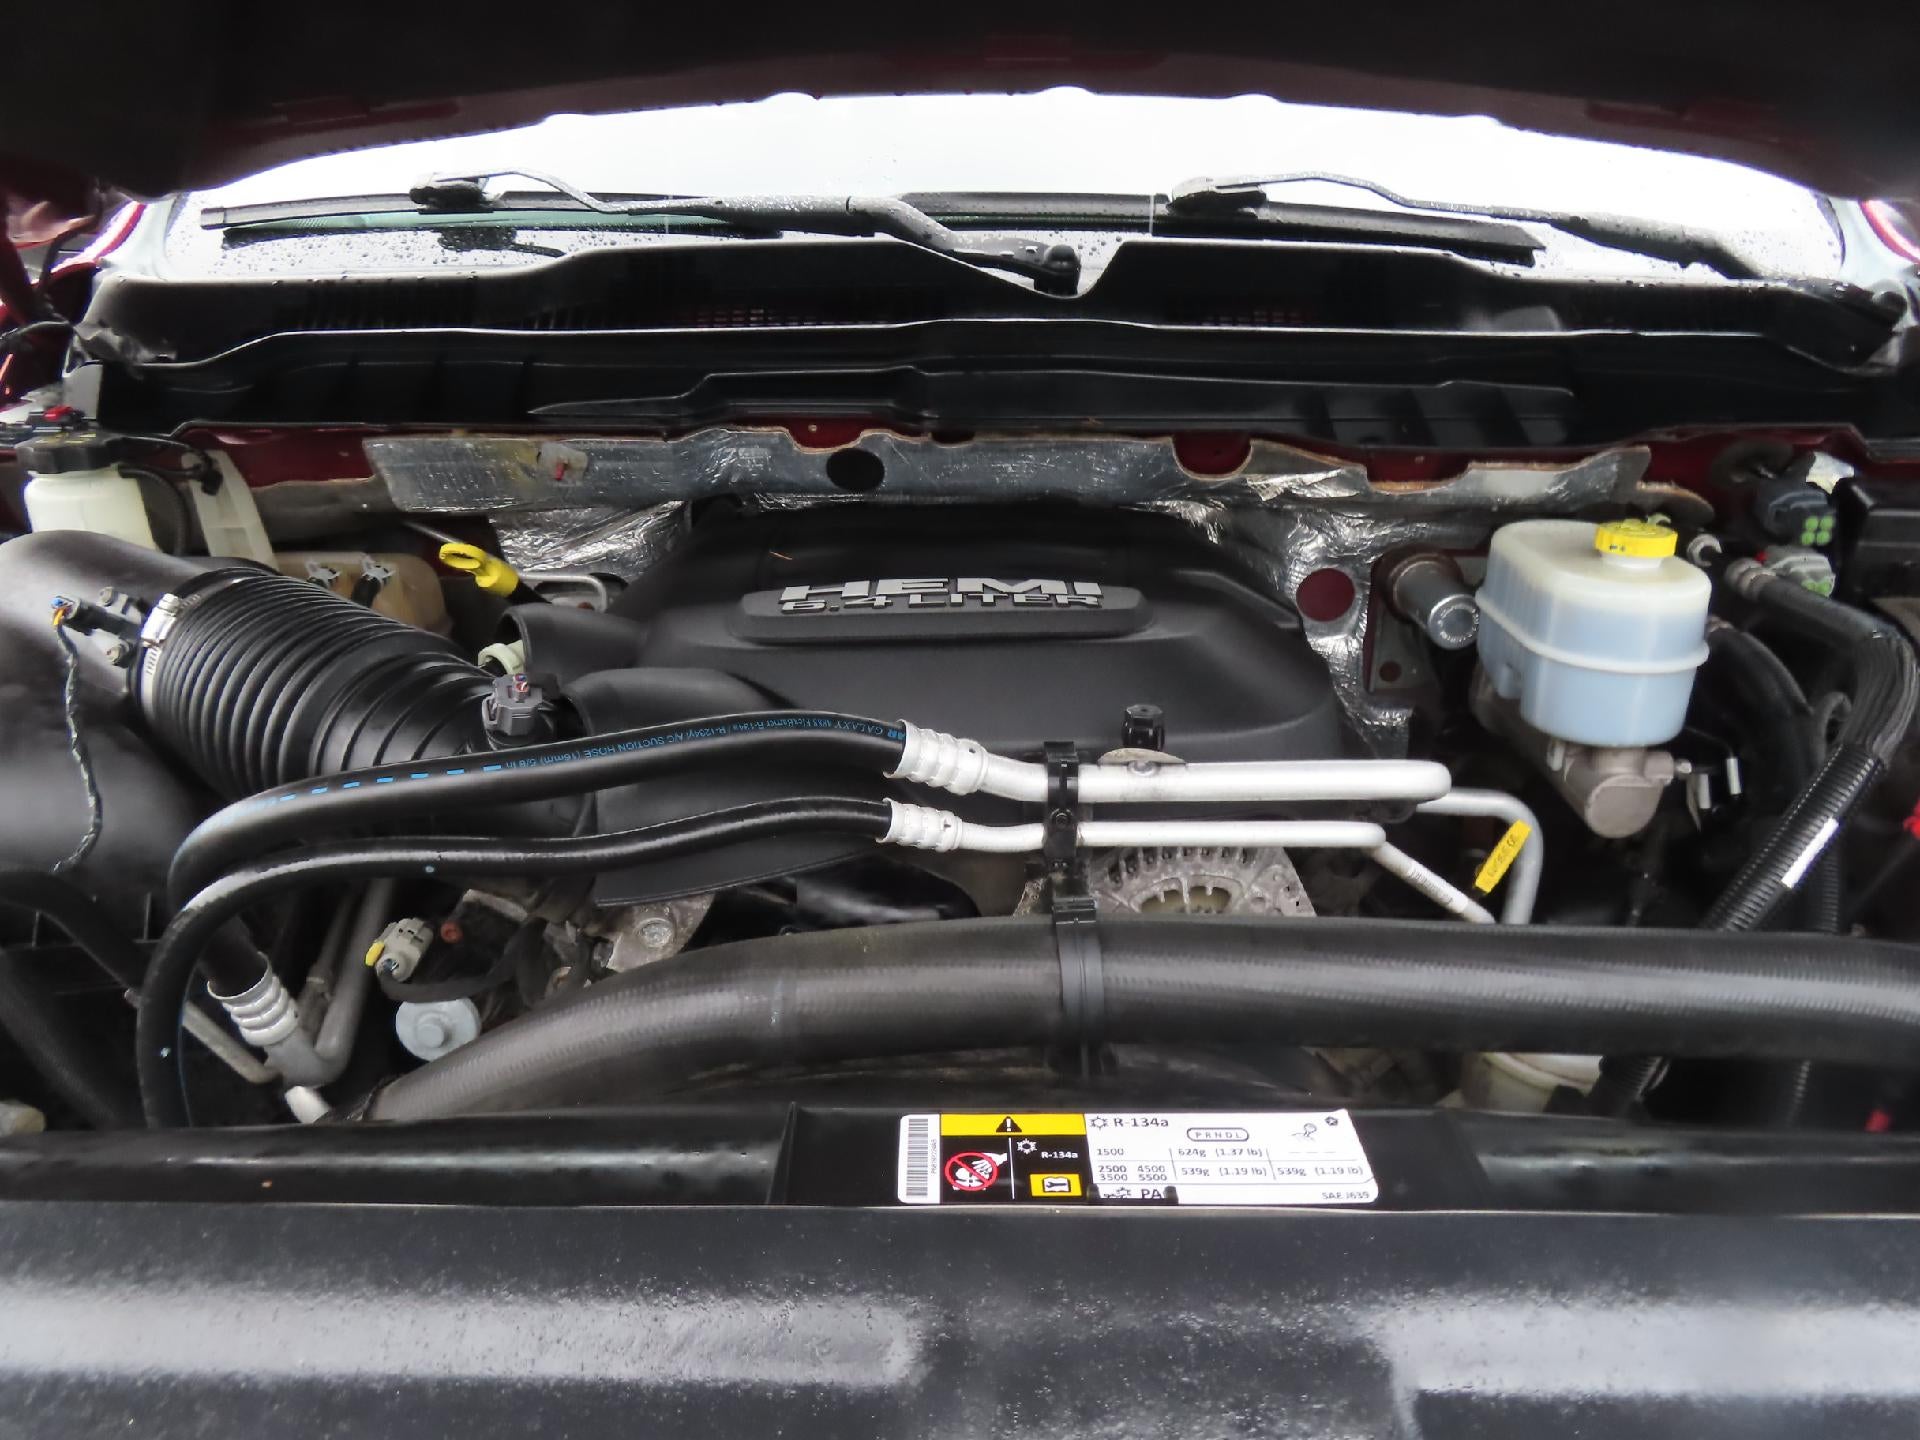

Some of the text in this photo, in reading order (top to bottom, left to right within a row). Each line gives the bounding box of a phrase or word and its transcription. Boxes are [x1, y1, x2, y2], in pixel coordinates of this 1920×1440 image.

[779, 577, 1101, 600] HEMI
[908, 593, 1099, 606] LITER
[835, 722, 883, 735] GALAXY
[667, 733, 683, 743] A/C
[619, 737, 664, 751] SUCTION
[586, 747, 614, 759] HOSE
[542, 752, 580, 765] (16mm)
[1114, 1117, 1169, 1127] R-134a
[1041, 1151, 1078, 1159] R-134a
[1097, 1148, 1124, 1156] 1500
[1178, 1147, 1263, 1158] 624g (1.37 lb)
[1098, 1165, 1165, 1173] 2500 4500
[1181, 1167, 1267, 1177] 539g (1.19 lb)
[1277, 1167, 1363, 1177] 539g (1.19 lb)
[1099, 1173, 1167, 1181] 3500 5500
[1322, 1191, 1342, 1199] SAE
